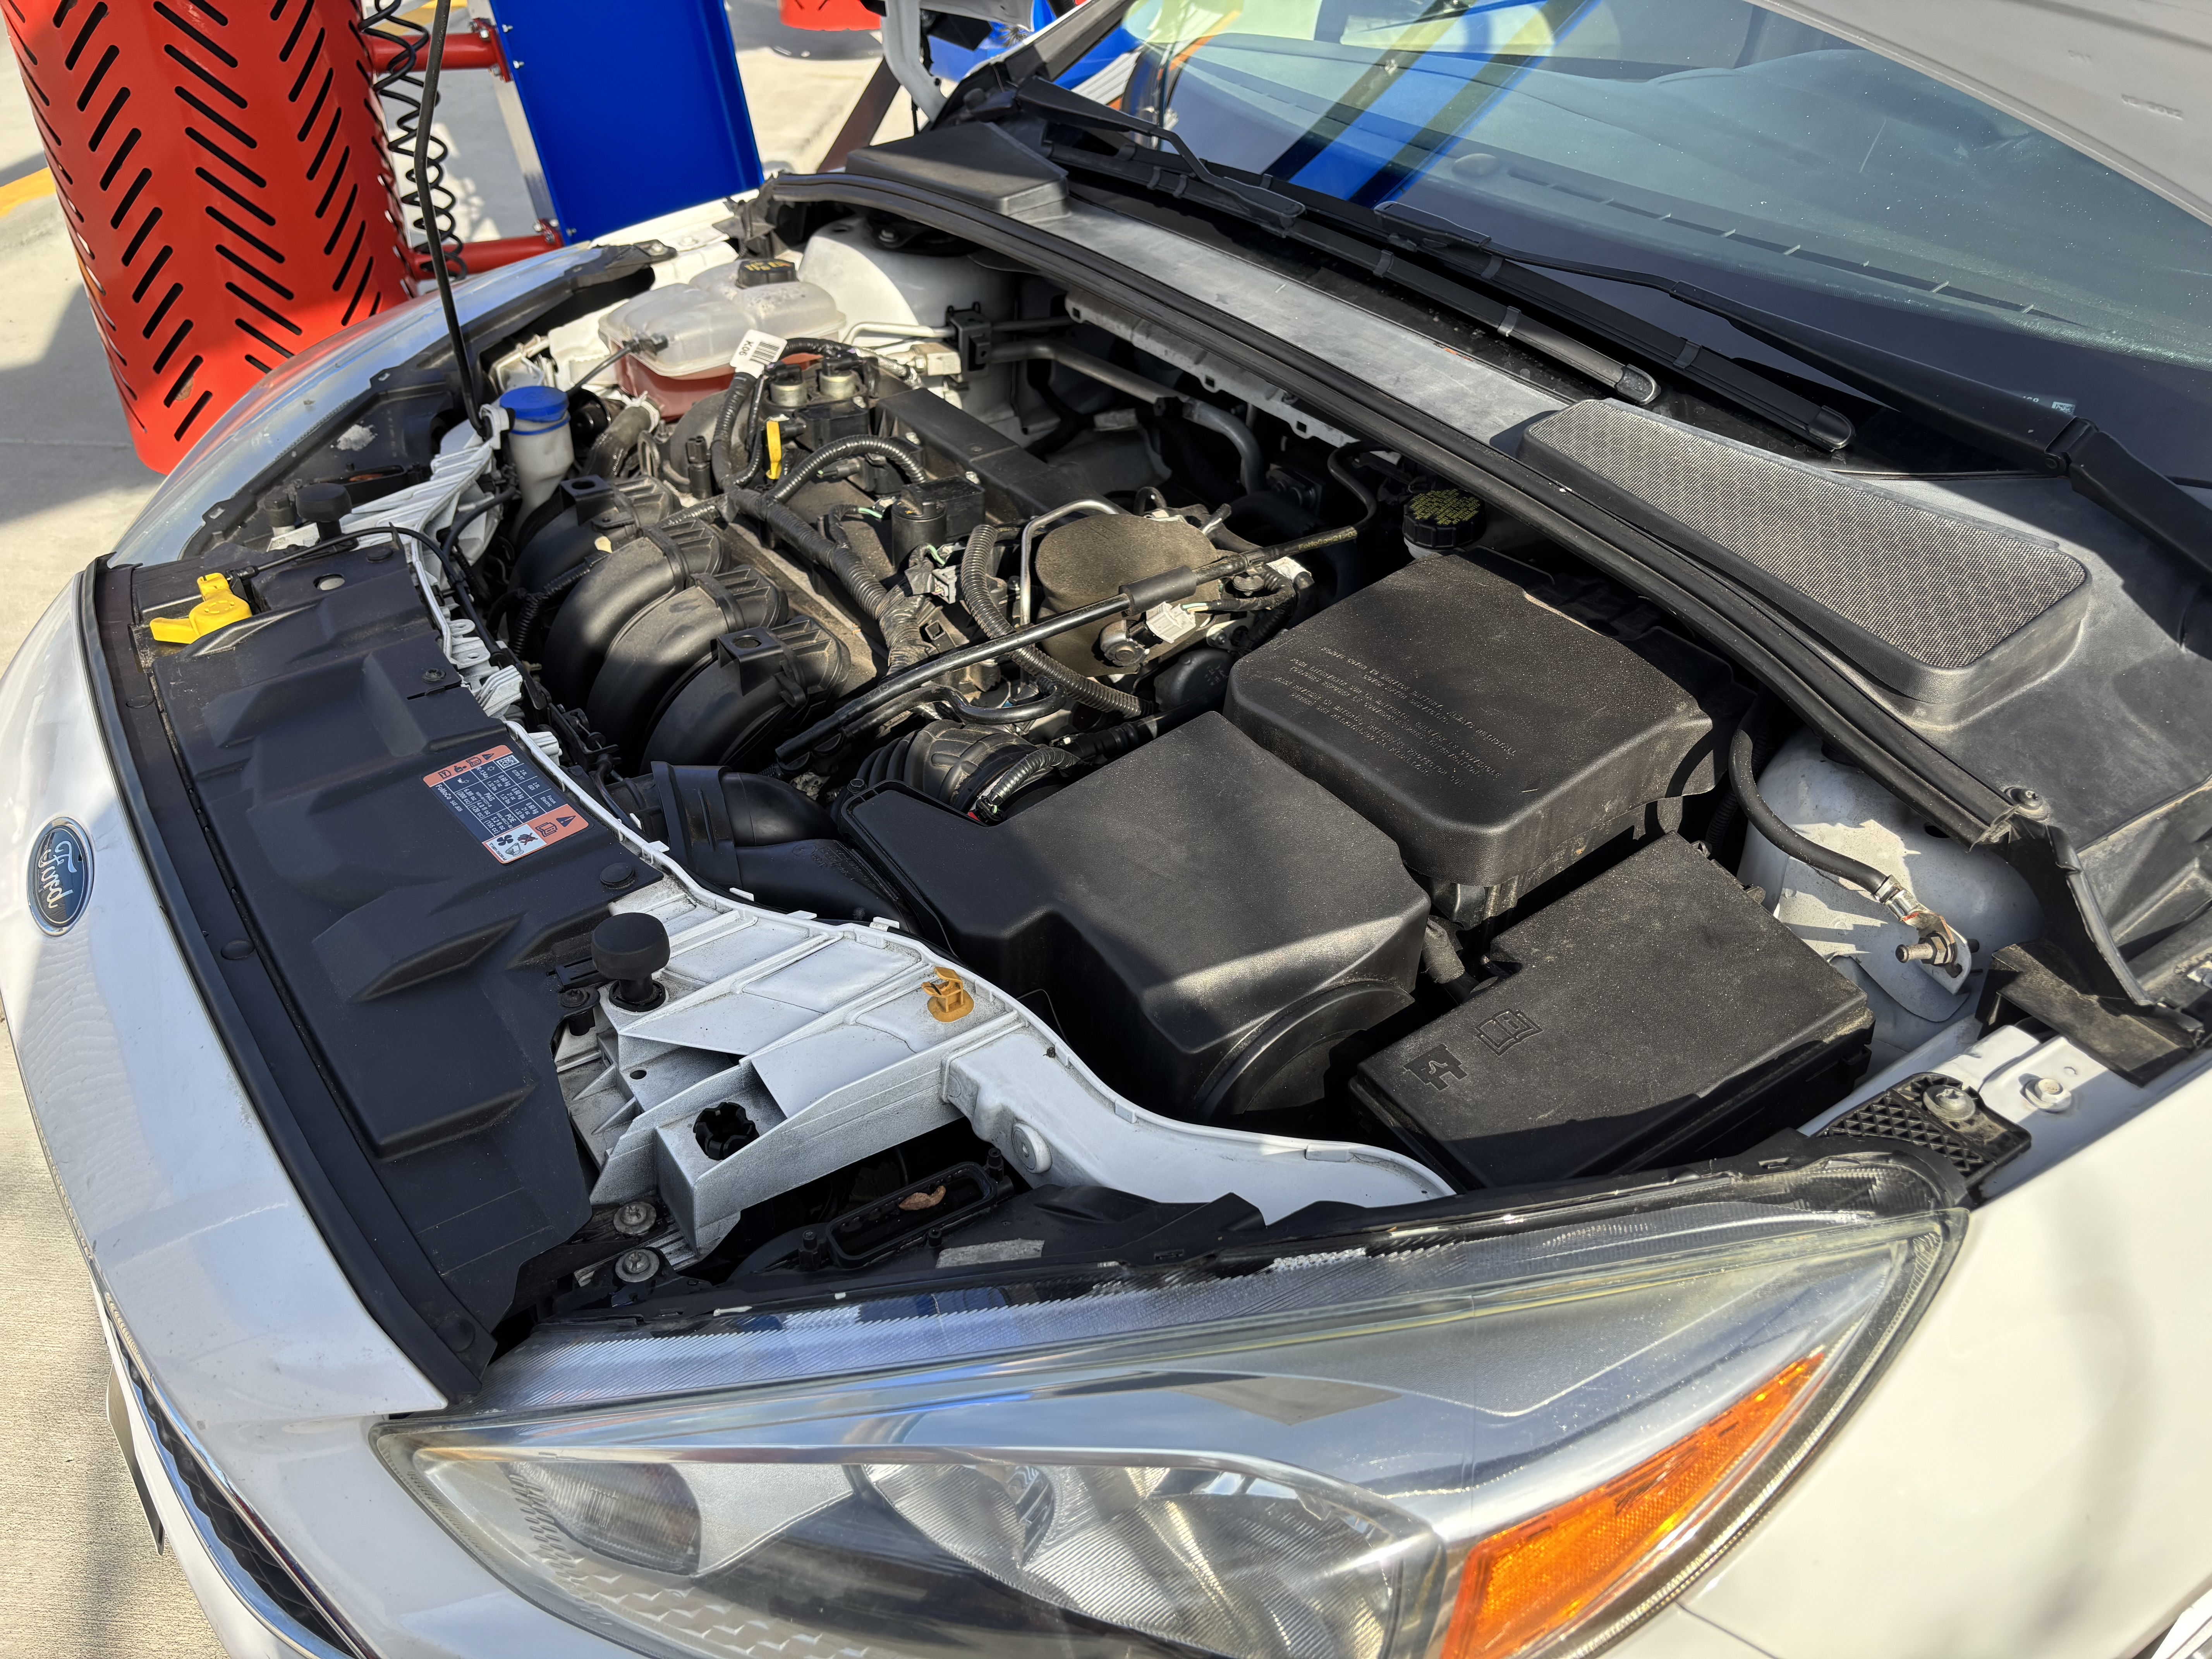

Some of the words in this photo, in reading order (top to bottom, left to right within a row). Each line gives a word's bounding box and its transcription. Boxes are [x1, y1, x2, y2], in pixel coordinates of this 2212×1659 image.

[475, 766, 490, 778] R-134a
[435, 784, 453, 800] FoMoCo
[455, 791, 467, 799] (200
[483, 792, 495, 801] PAG
[540, 796, 553, 807] Electric
[546, 795, 557, 804] Focus
[468, 804, 481, 813] (120
[525, 802, 536, 810] 0.60
[505, 813, 517, 823] POE
[483, 819, 495, 829] (155
[38, 840, 77, 908] Ford
